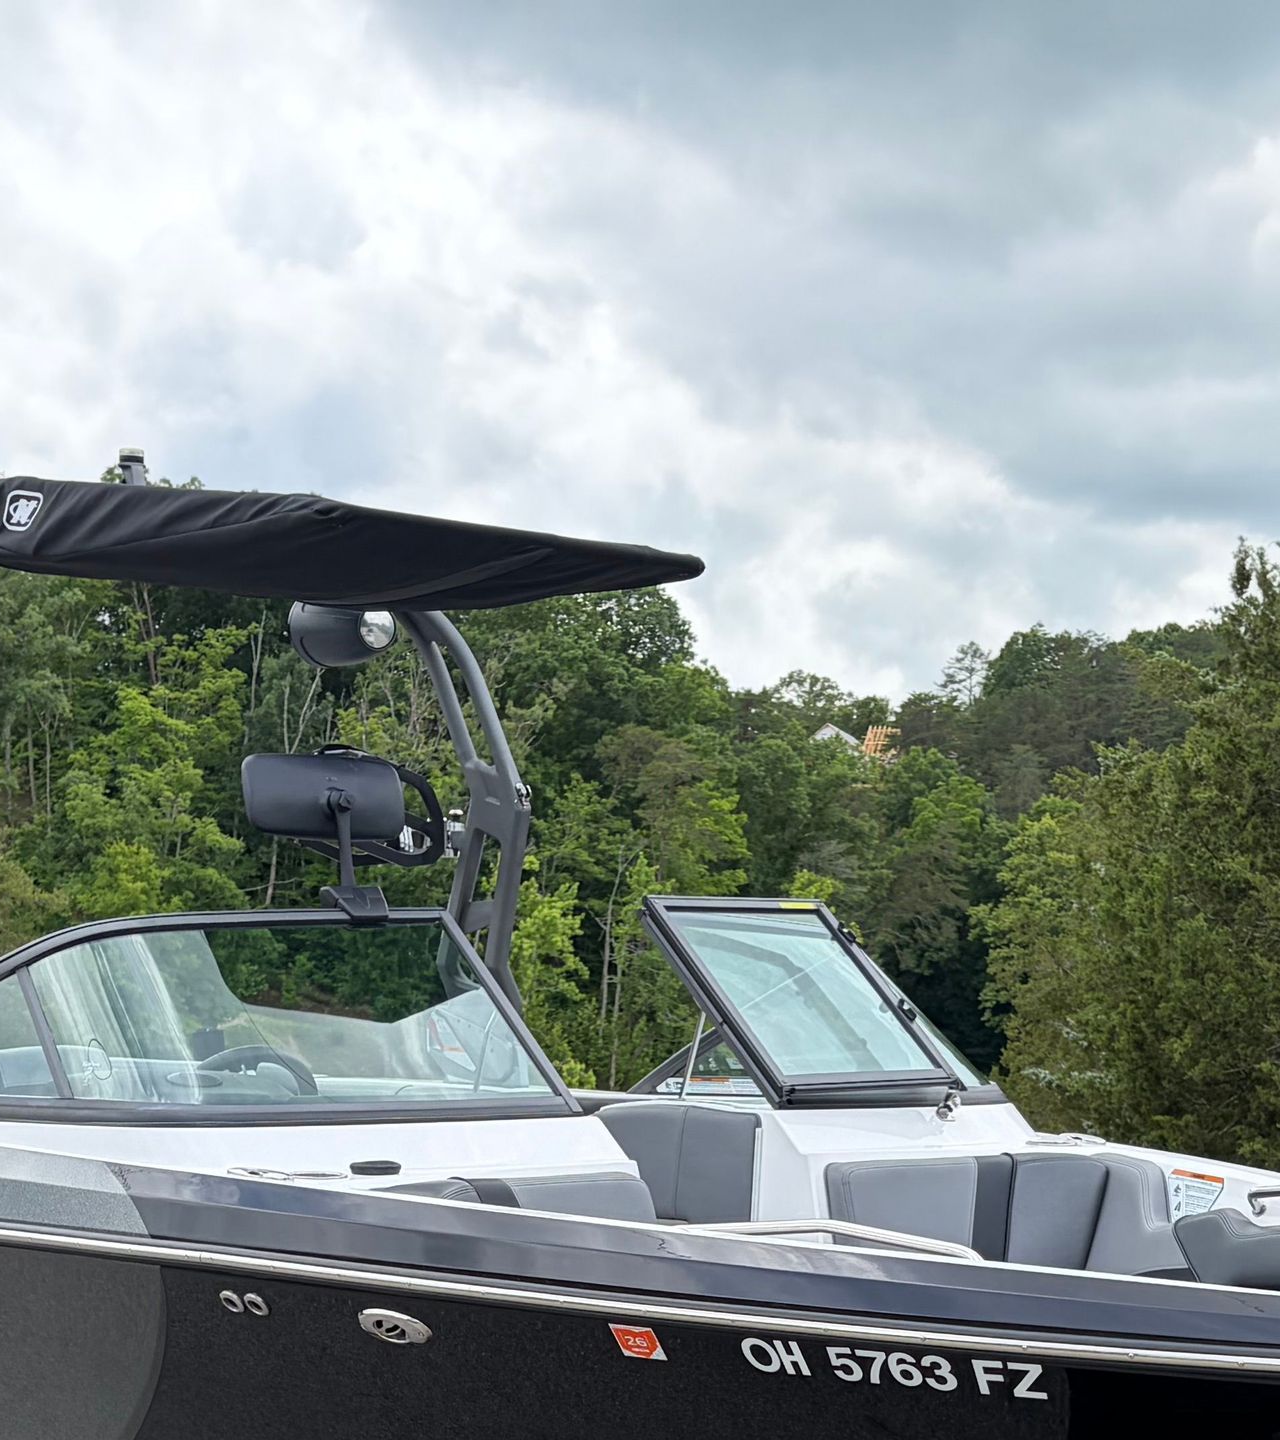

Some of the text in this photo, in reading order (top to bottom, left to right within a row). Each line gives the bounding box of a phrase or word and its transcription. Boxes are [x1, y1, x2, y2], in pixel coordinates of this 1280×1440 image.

[624, 1335, 648, 1348] 26
[740, 1337, 1049, 1400] OH 5763 FZ
